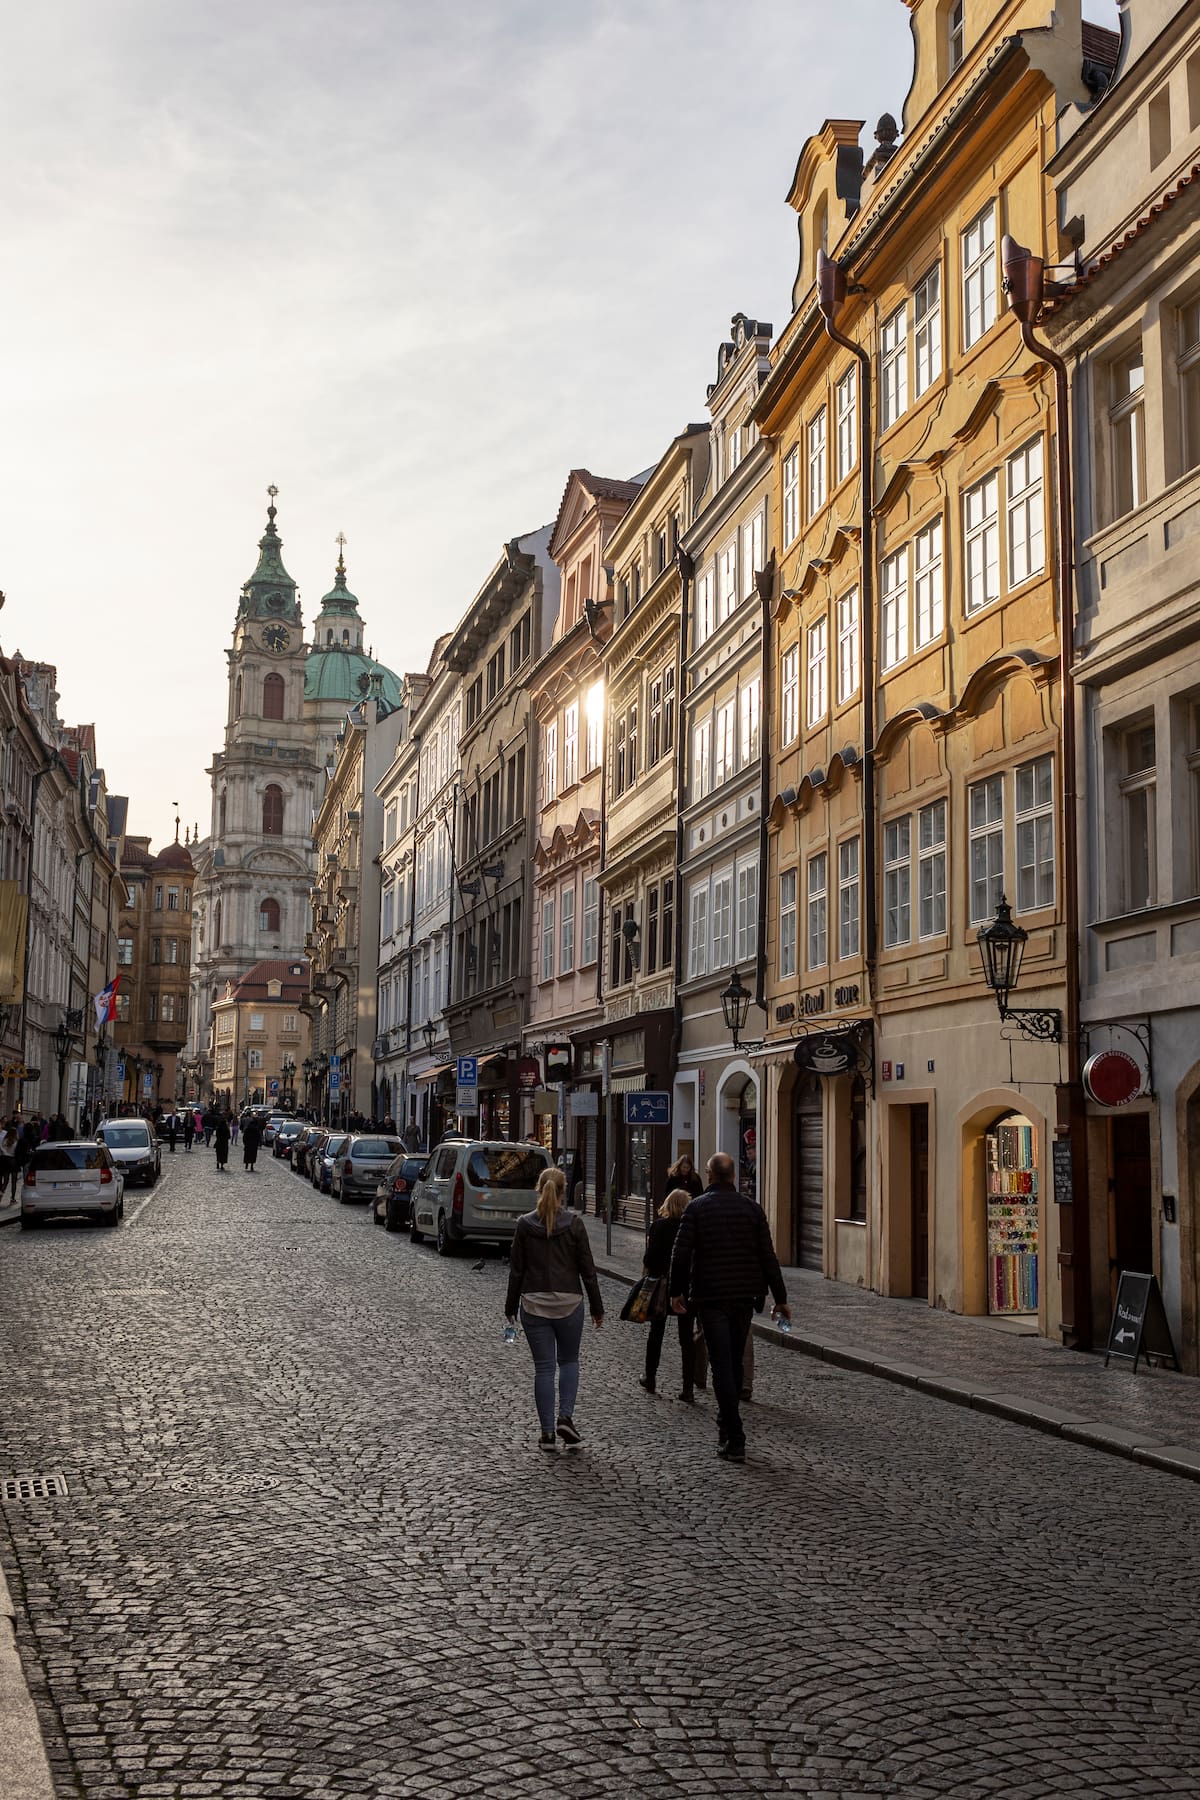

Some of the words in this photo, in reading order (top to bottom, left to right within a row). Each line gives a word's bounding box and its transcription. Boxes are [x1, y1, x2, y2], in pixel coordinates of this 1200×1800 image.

[805, 989, 824, 1014] food
[835, 984, 859, 1006] store
[461, 1061, 474, 1078] P
[331, 1074, 338, 1084] P
